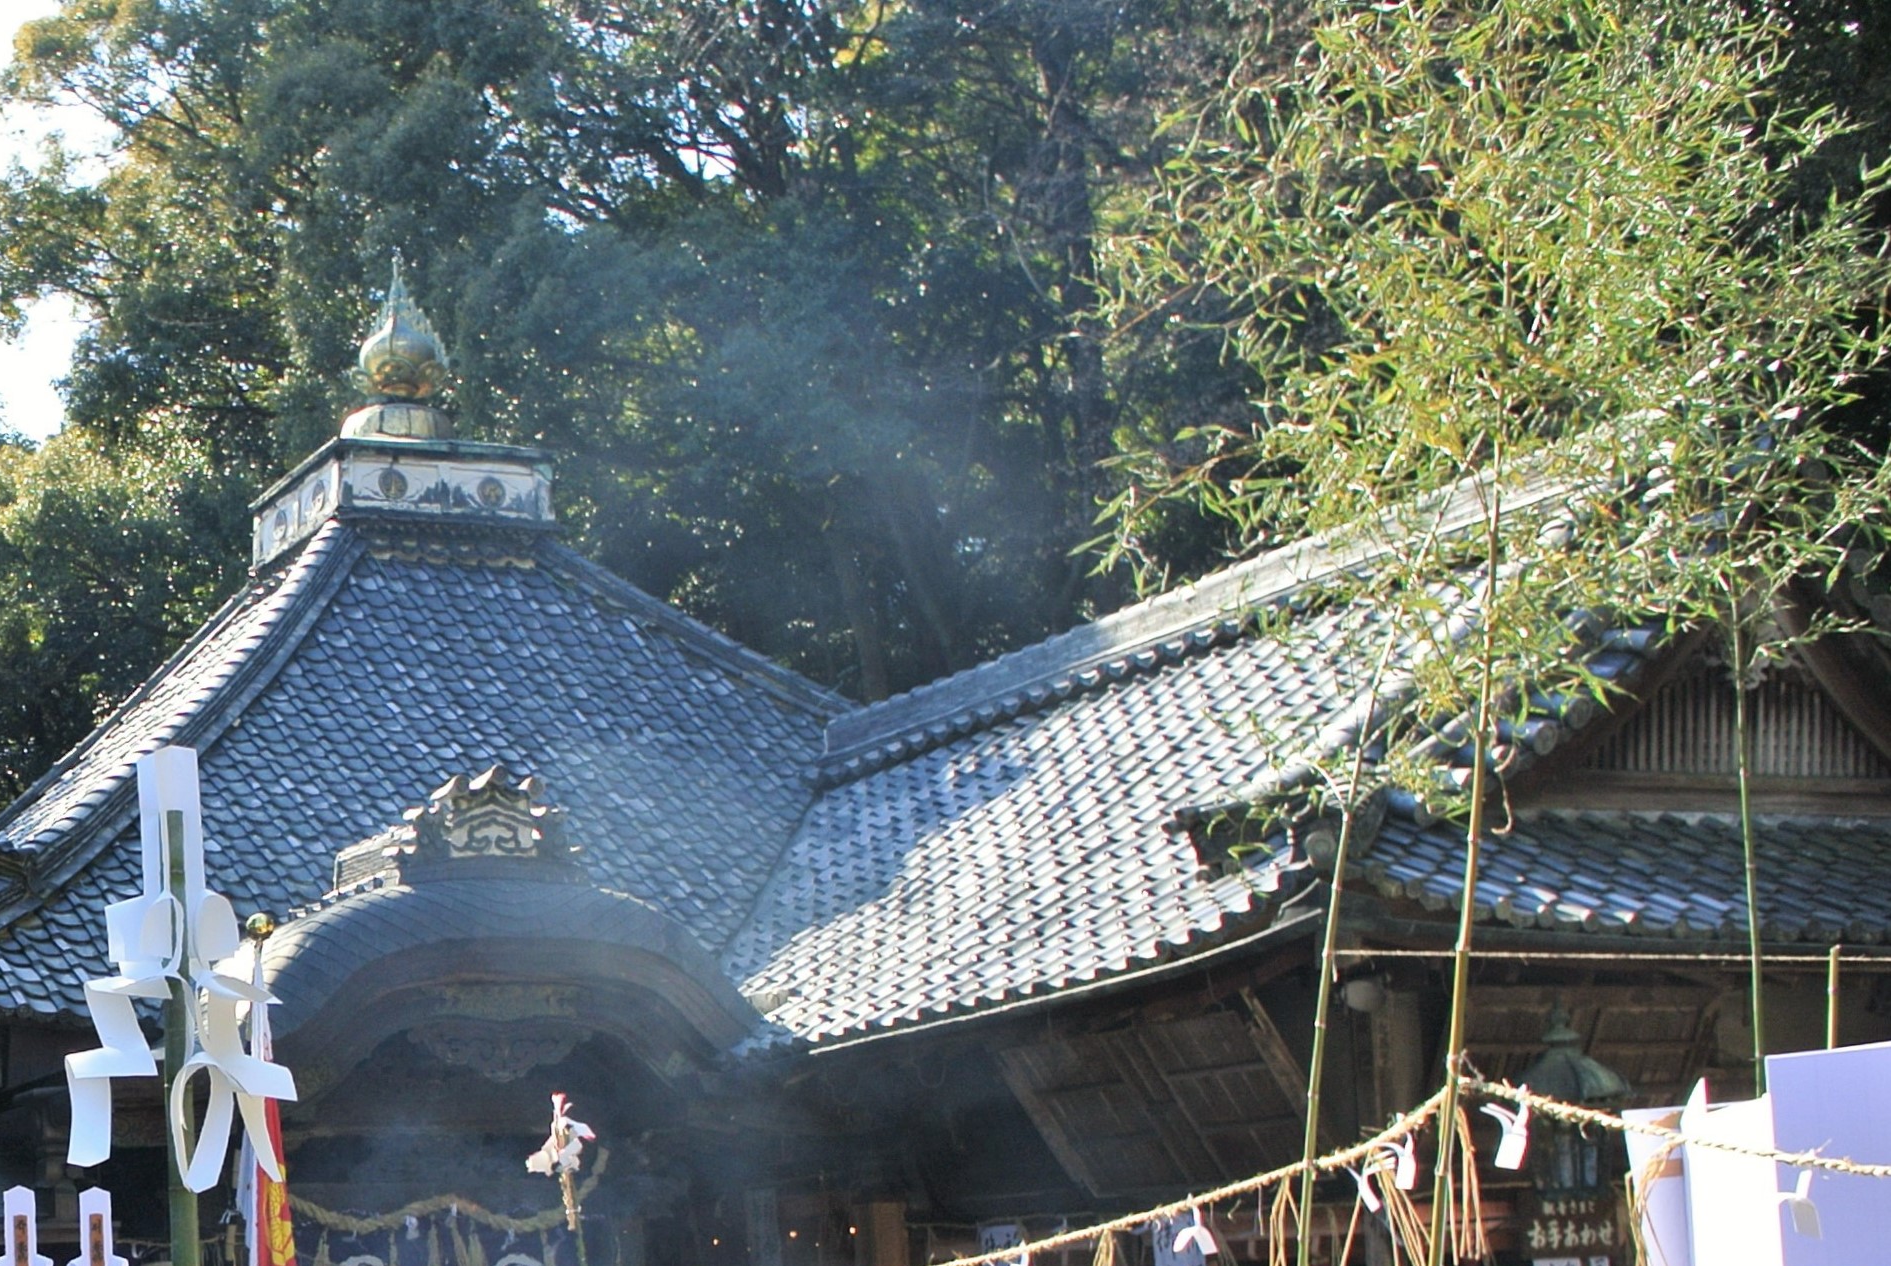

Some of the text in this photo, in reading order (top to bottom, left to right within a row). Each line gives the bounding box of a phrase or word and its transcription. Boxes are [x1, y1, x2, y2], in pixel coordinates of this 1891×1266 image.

[1527, 1218, 1613, 1249] お手あわせ
